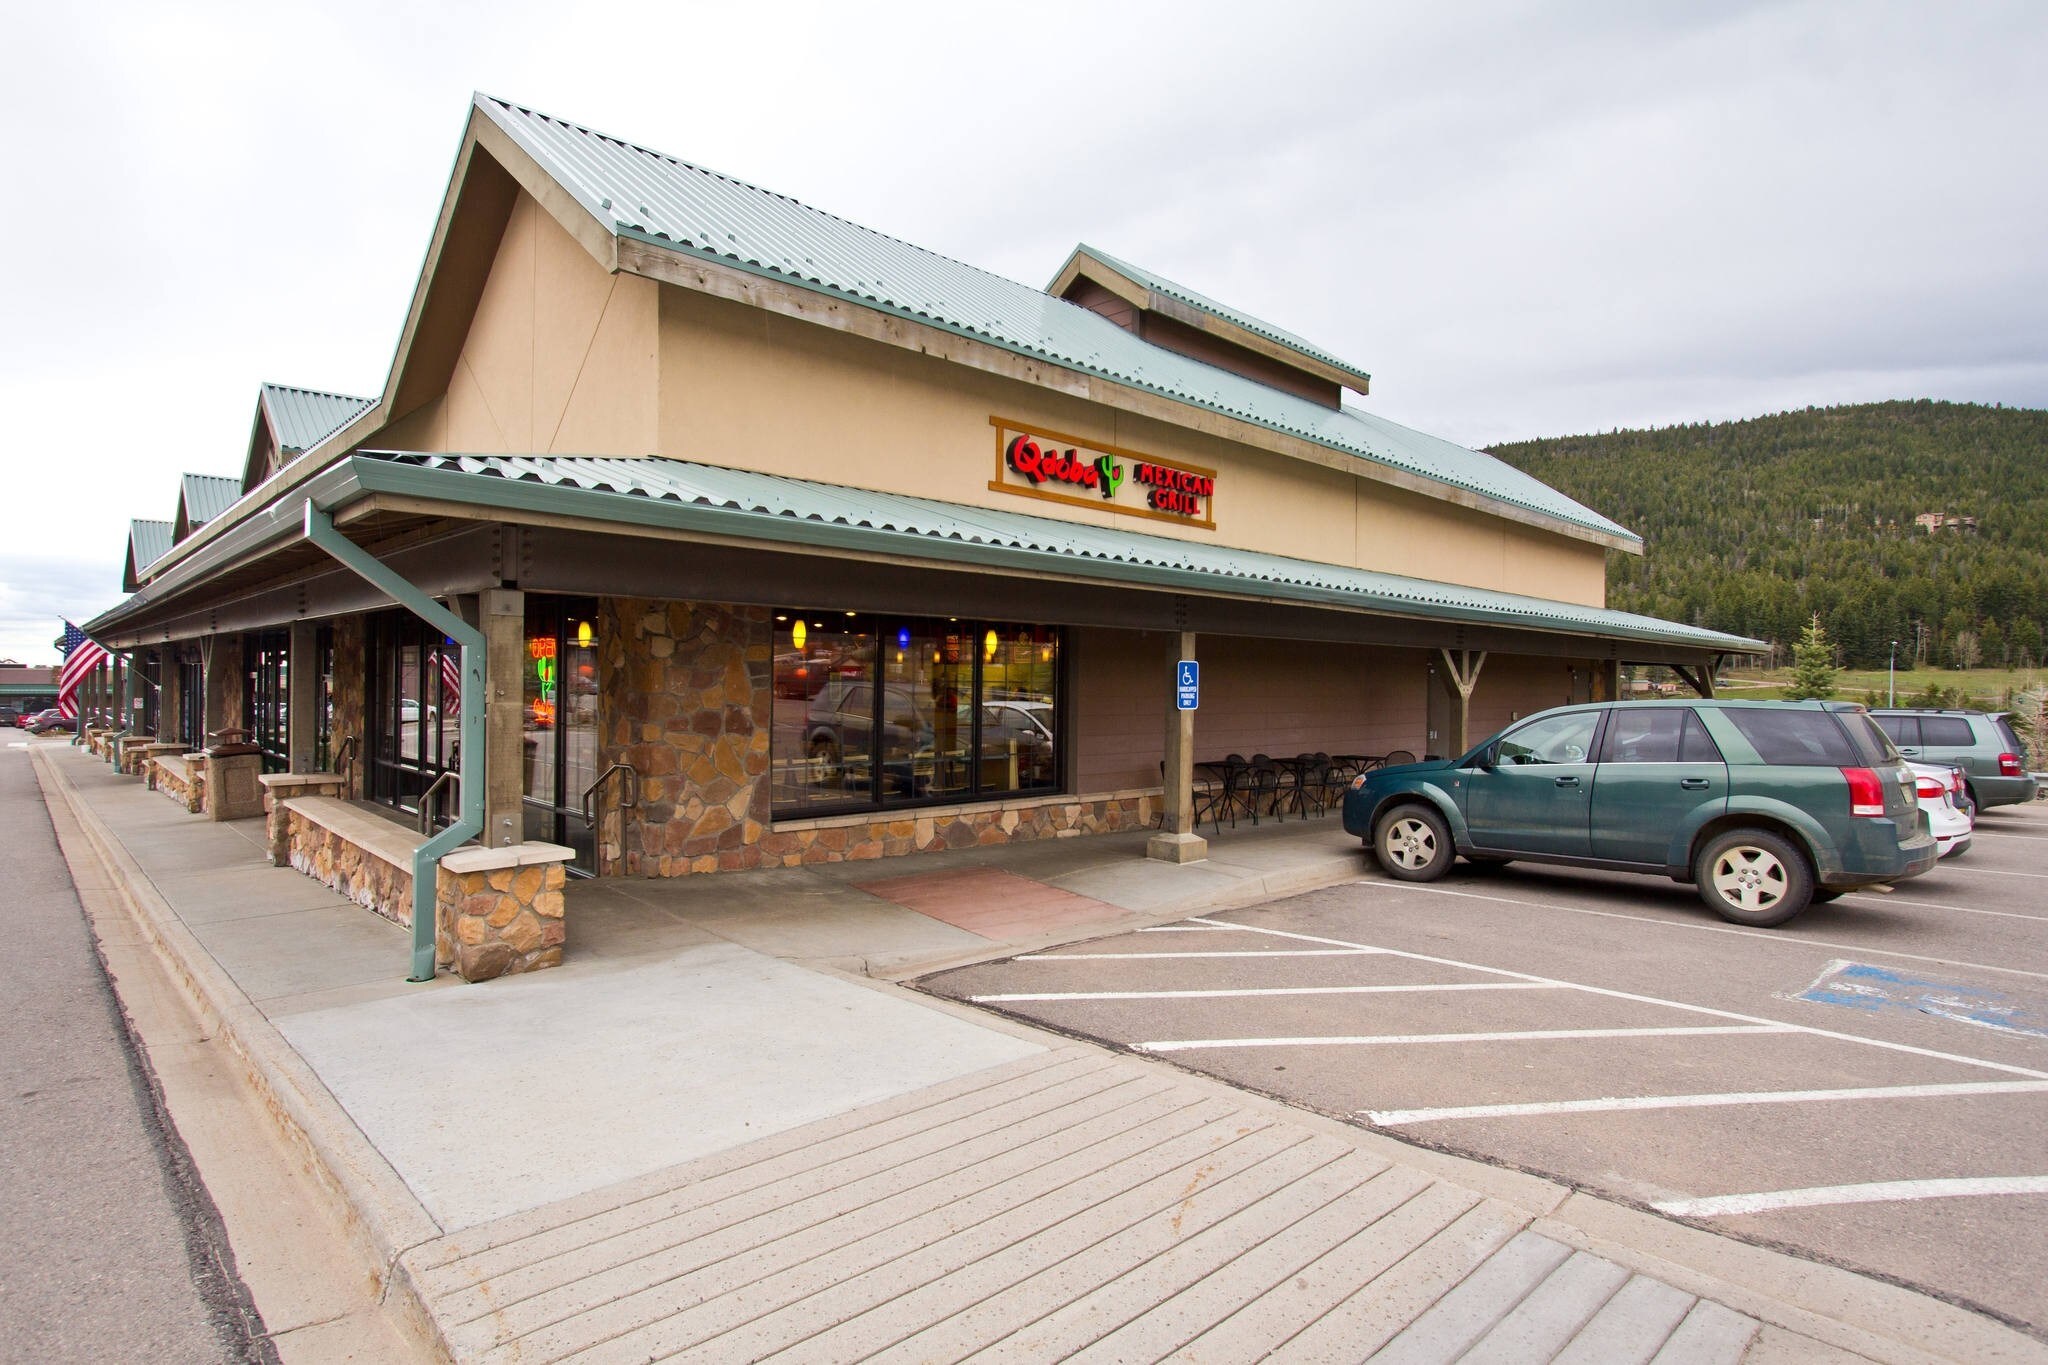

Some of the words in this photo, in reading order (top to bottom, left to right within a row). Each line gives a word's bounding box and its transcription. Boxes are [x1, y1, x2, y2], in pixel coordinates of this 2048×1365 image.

[1013, 433, 1099, 488] Qdoba
[1140, 463, 1214, 496] MEXICAN
[1155, 488, 1200, 514] GRILL
